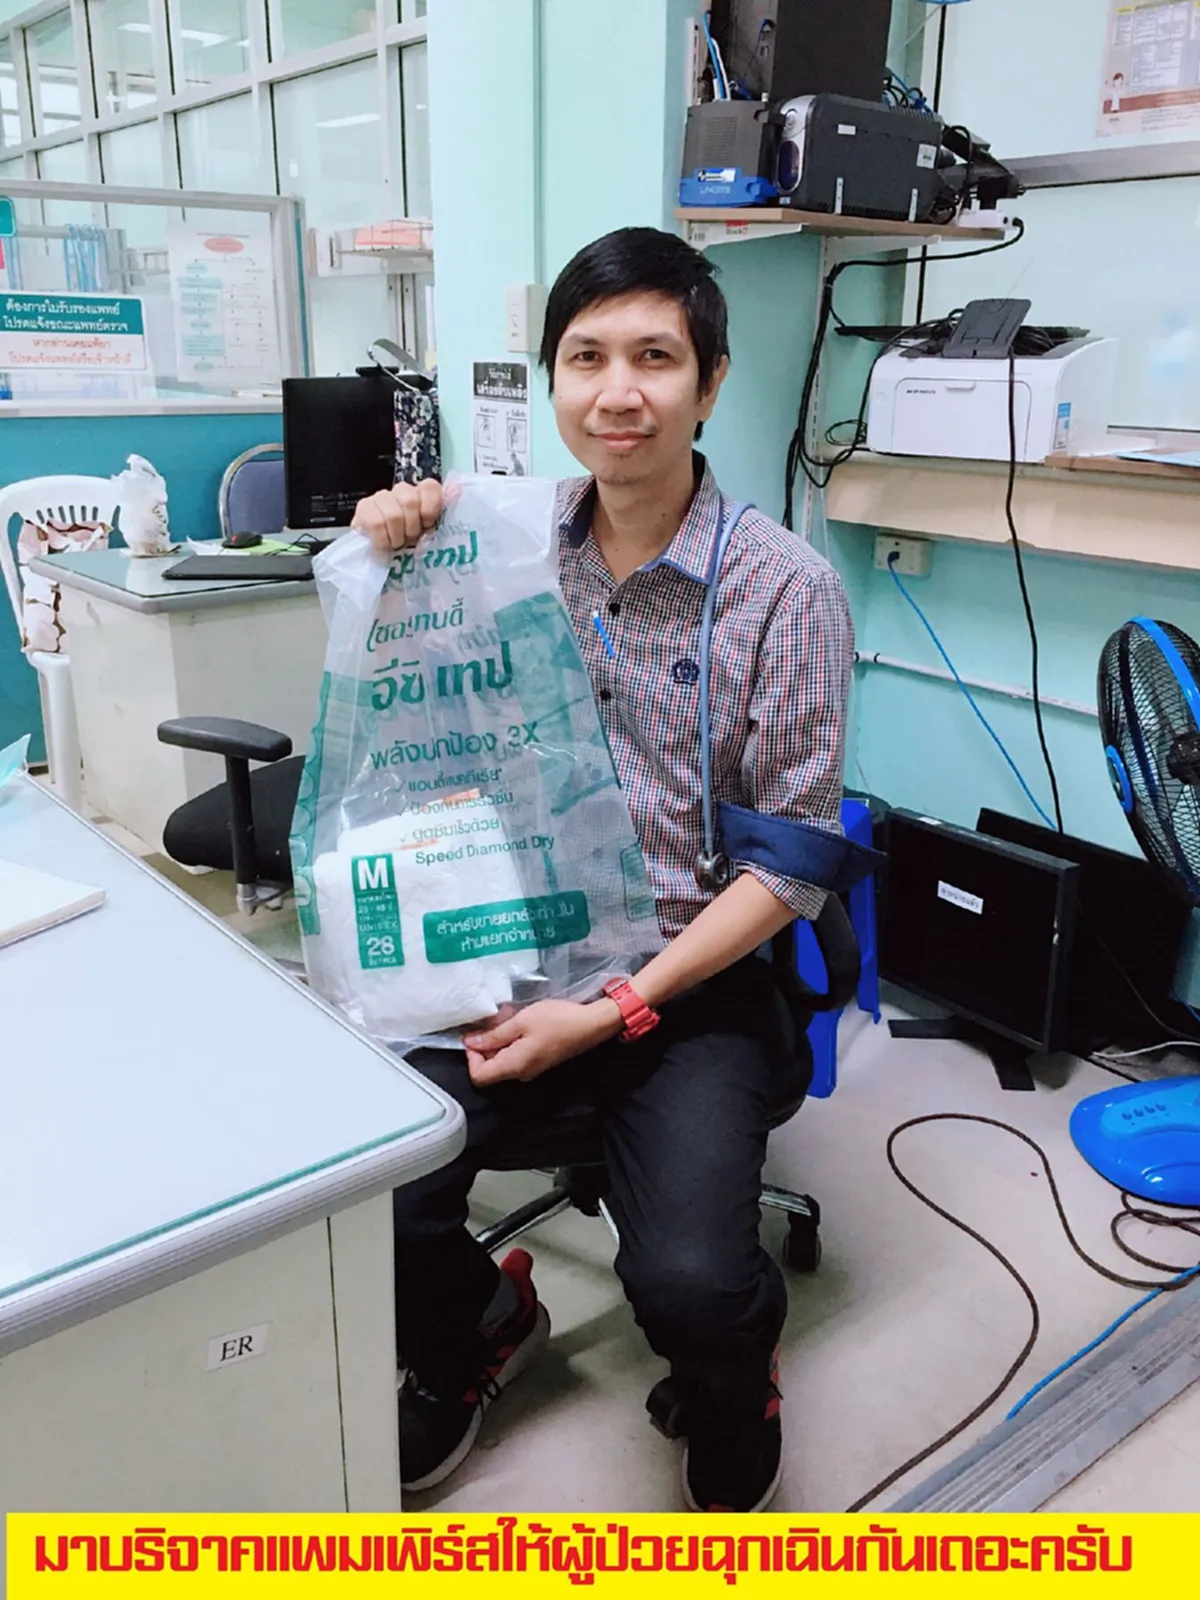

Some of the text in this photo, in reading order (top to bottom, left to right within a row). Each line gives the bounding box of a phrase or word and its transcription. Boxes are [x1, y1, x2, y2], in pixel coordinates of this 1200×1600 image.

[6, 298, 120, 315] ต้องการใบรับรองแพทย์
[3, 315, 128, 331] โปรดแจ้งขณะแพทย์ตรวจ
[437, 641, 513, 697] เทป
[371, 721, 541, 770] พลังปกป้อง 3X
[415, 834, 555, 866] Speed Diamond Dry
[358, 857, 389, 890] M
[359, 921, 398, 932] UNISEX
[461, 925, 555, 953] ห้ามแยกจำหาย
[366, 936, 395, 956] 28
[220, 1335, 253, 1362] ER
